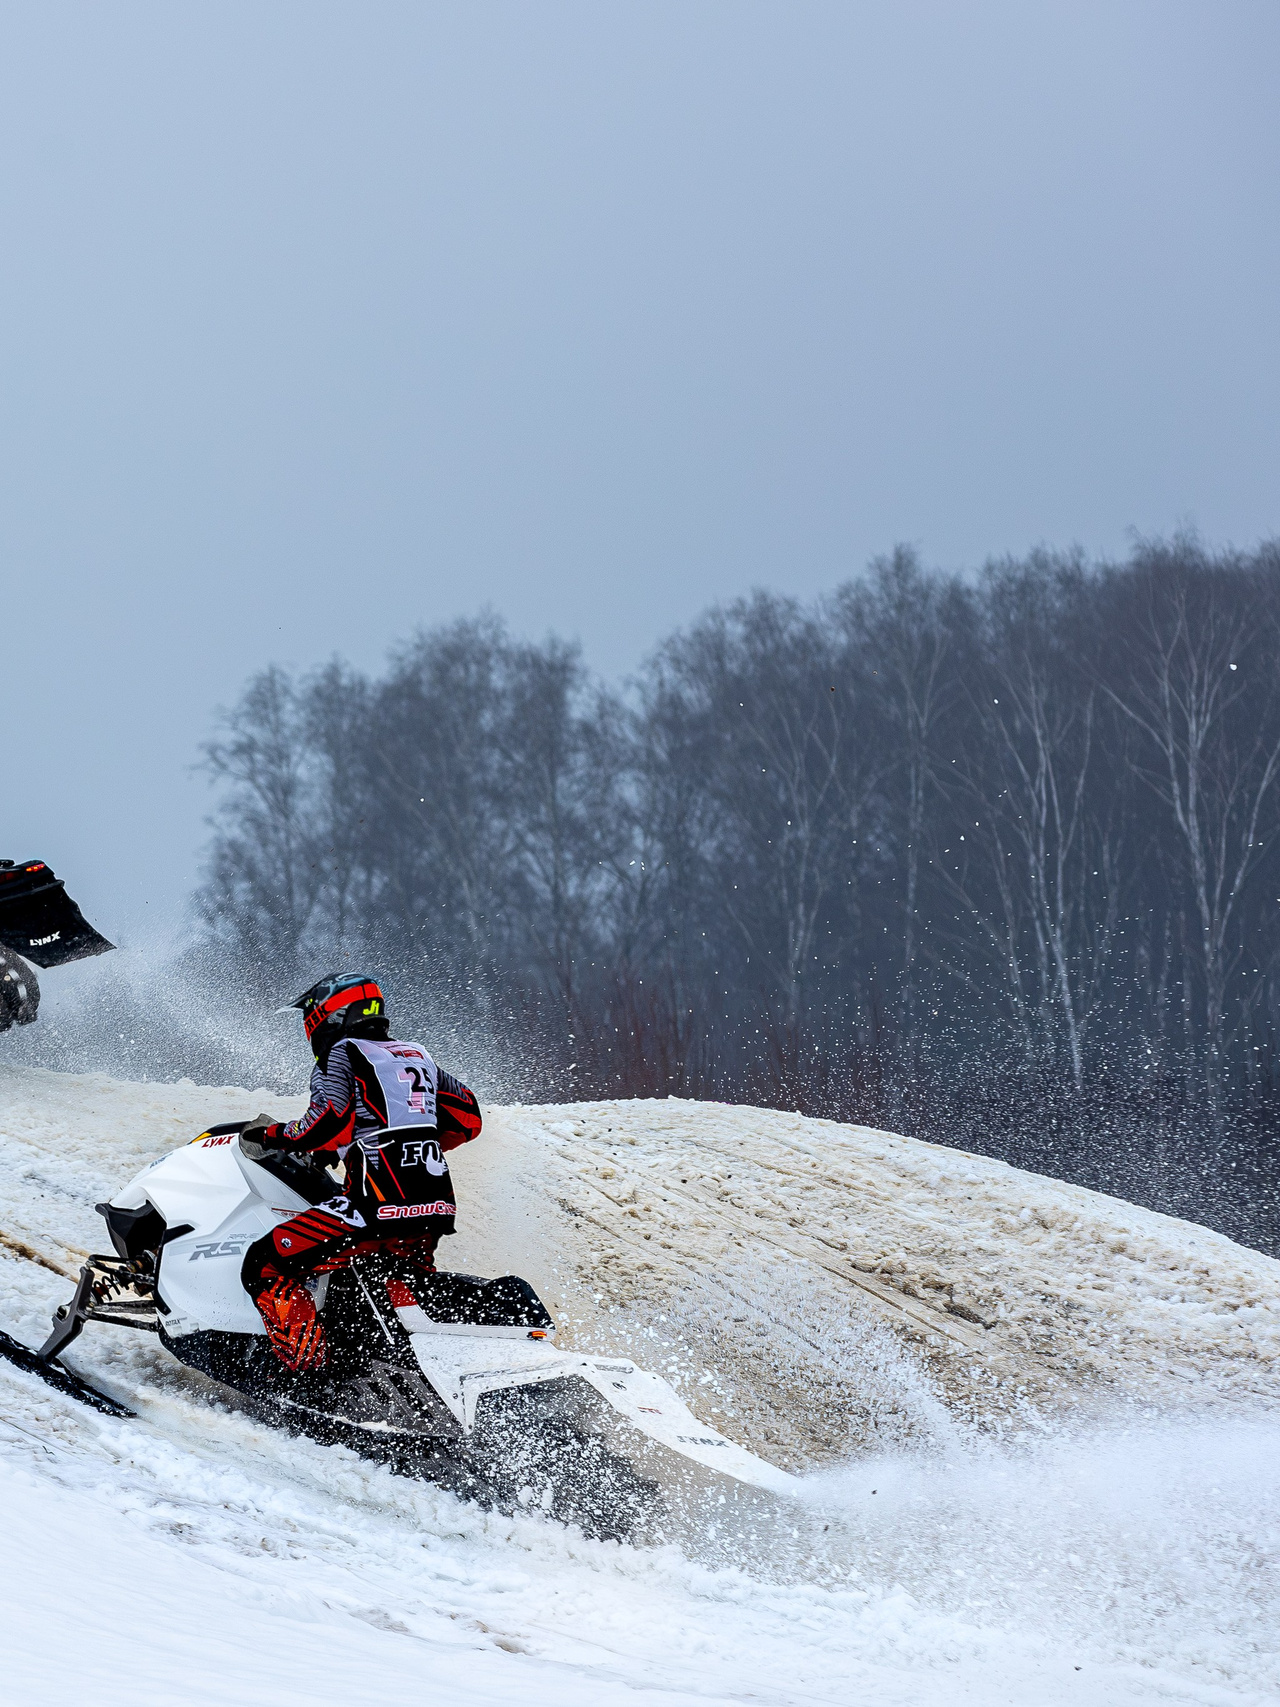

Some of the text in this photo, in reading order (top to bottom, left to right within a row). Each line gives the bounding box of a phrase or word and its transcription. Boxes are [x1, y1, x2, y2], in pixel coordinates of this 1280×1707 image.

[29, 930, 61, 946] LYNX
[201, 1134, 235, 1148] LYNX
[189, 1240, 246, 1261] RS
